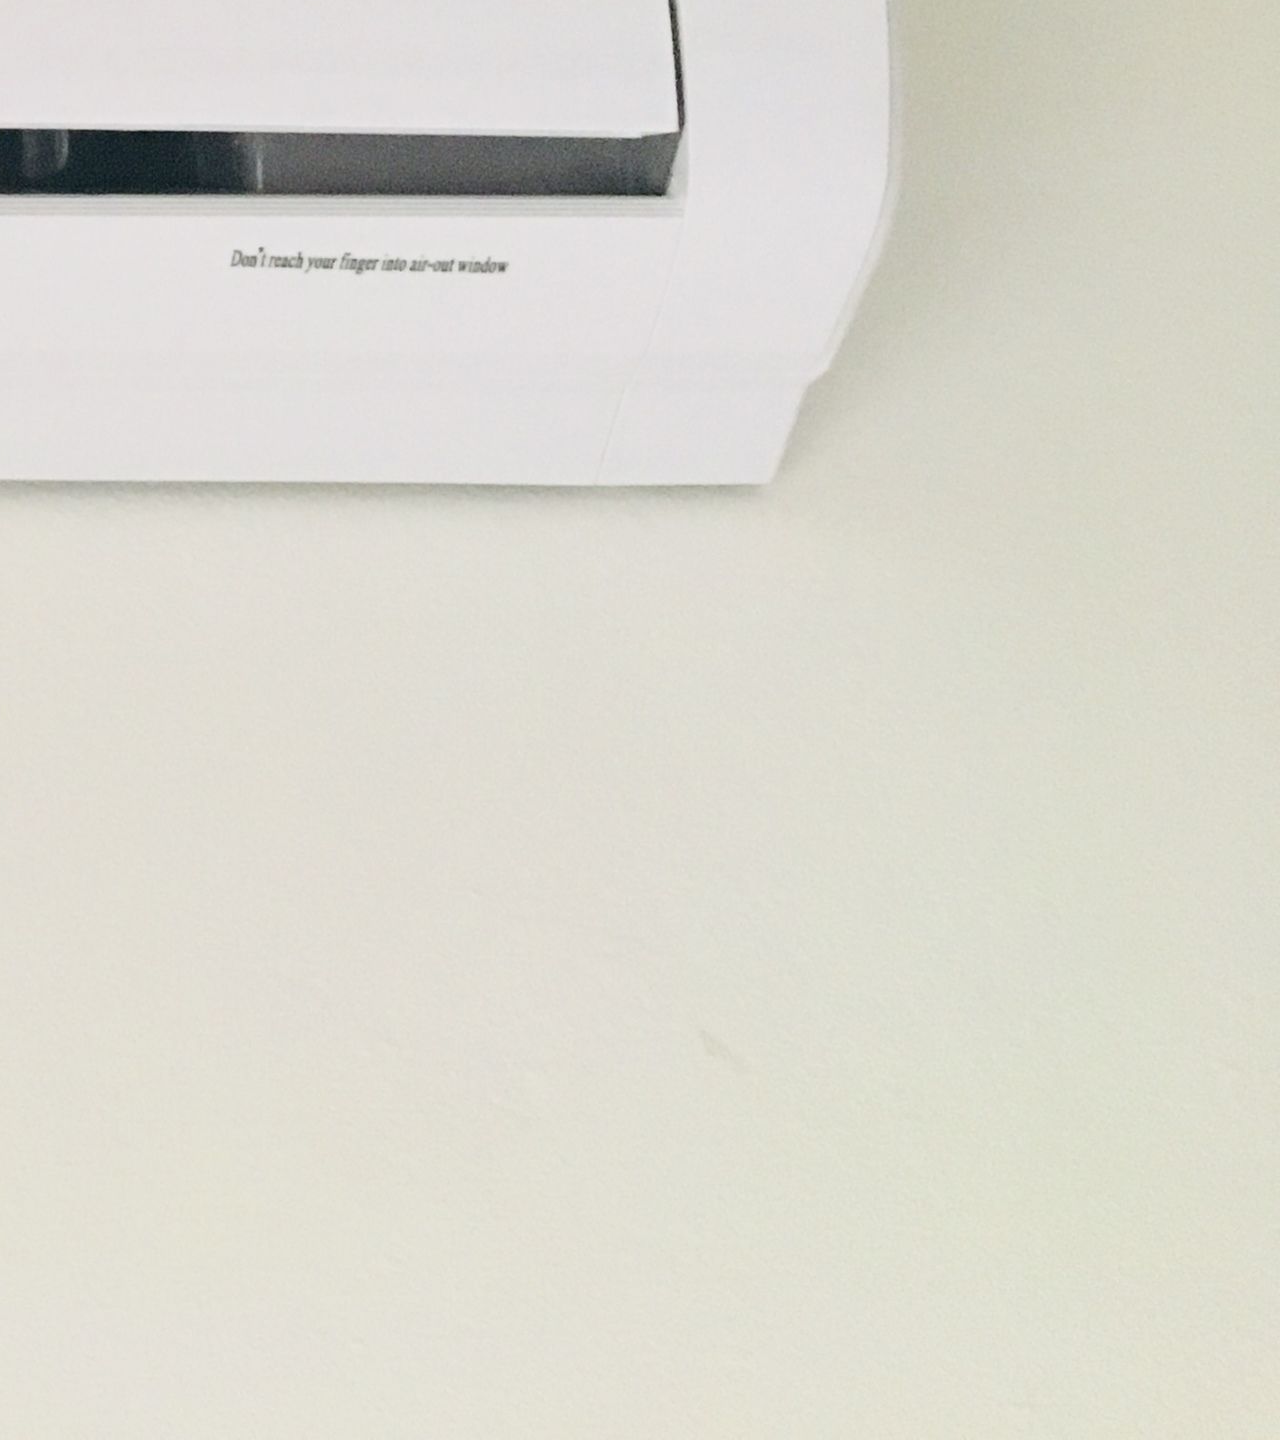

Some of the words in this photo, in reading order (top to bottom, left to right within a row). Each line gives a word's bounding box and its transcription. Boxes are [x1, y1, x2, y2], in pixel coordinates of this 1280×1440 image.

[230, 246, 267, 269] Don't
[268, 252, 304, 270] reach
[305, 256, 337, 274] your
[339, 252, 380, 276] finger
[381, 254, 407, 273] into
[409, 255, 455, 273] air-out
[457, 256, 510, 274] window
